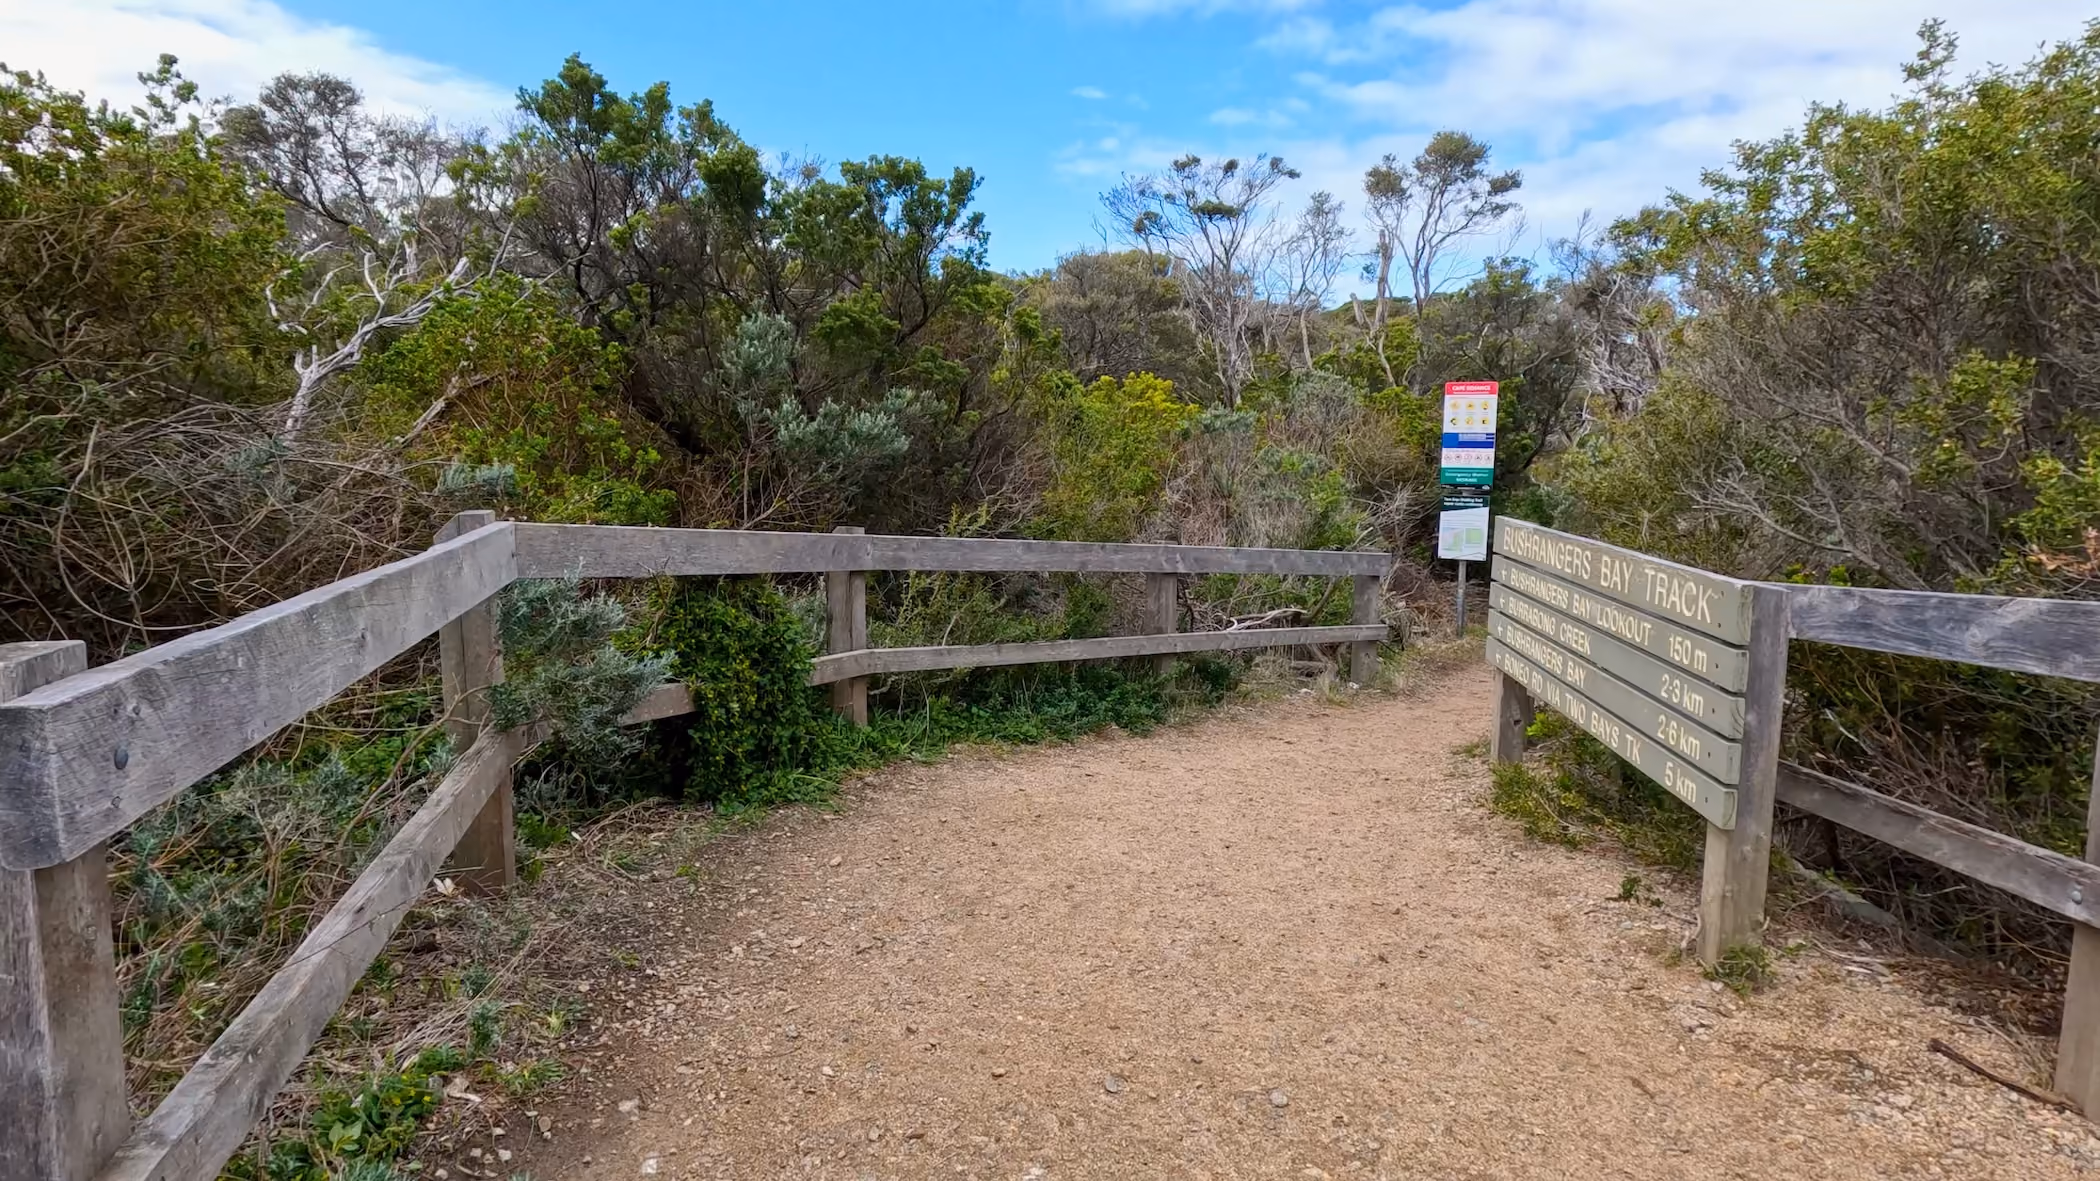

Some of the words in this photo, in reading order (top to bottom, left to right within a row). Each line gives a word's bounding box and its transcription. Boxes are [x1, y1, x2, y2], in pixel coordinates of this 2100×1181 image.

[1503, 527, 1592, 580] BUSHRANGERS
[1600, 554, 1633, 594] BAY
[1644, 568, 1712, 624] TRACK
[1510, 568, 1569, 609] BUSHRANGERS
[1572, 593, 1592, 619] BAY
[1597, 606, 1652, 646] LOOKOUT
[1669, 634, 1692, 665] 150
[1694, 649, 1708, 673] m
[1506, 626, 1563, 675] BUSHRANGERS
[1567, 663, 1587, 689] BAY
[1680, 725, 1700, 761] km
[1508, 597, 1556, 636] BURRABONG
[1560, 622, 1591, 656] CREEK
[1683, 684, 1704, 718] km
[1504, 654, 1530, 684] BONEO
[1532, 671, 1543, 693] RD
[1546, 681, 1561, 707] VIA
[1565, 693, 1586, 724] TWO
[1591, 711, 1620, 748] BAYS
[1626, 734, 1641, 765] TK
[1664, 762, 1674, 787] 5
[1676, 768, 1696, 803] km
